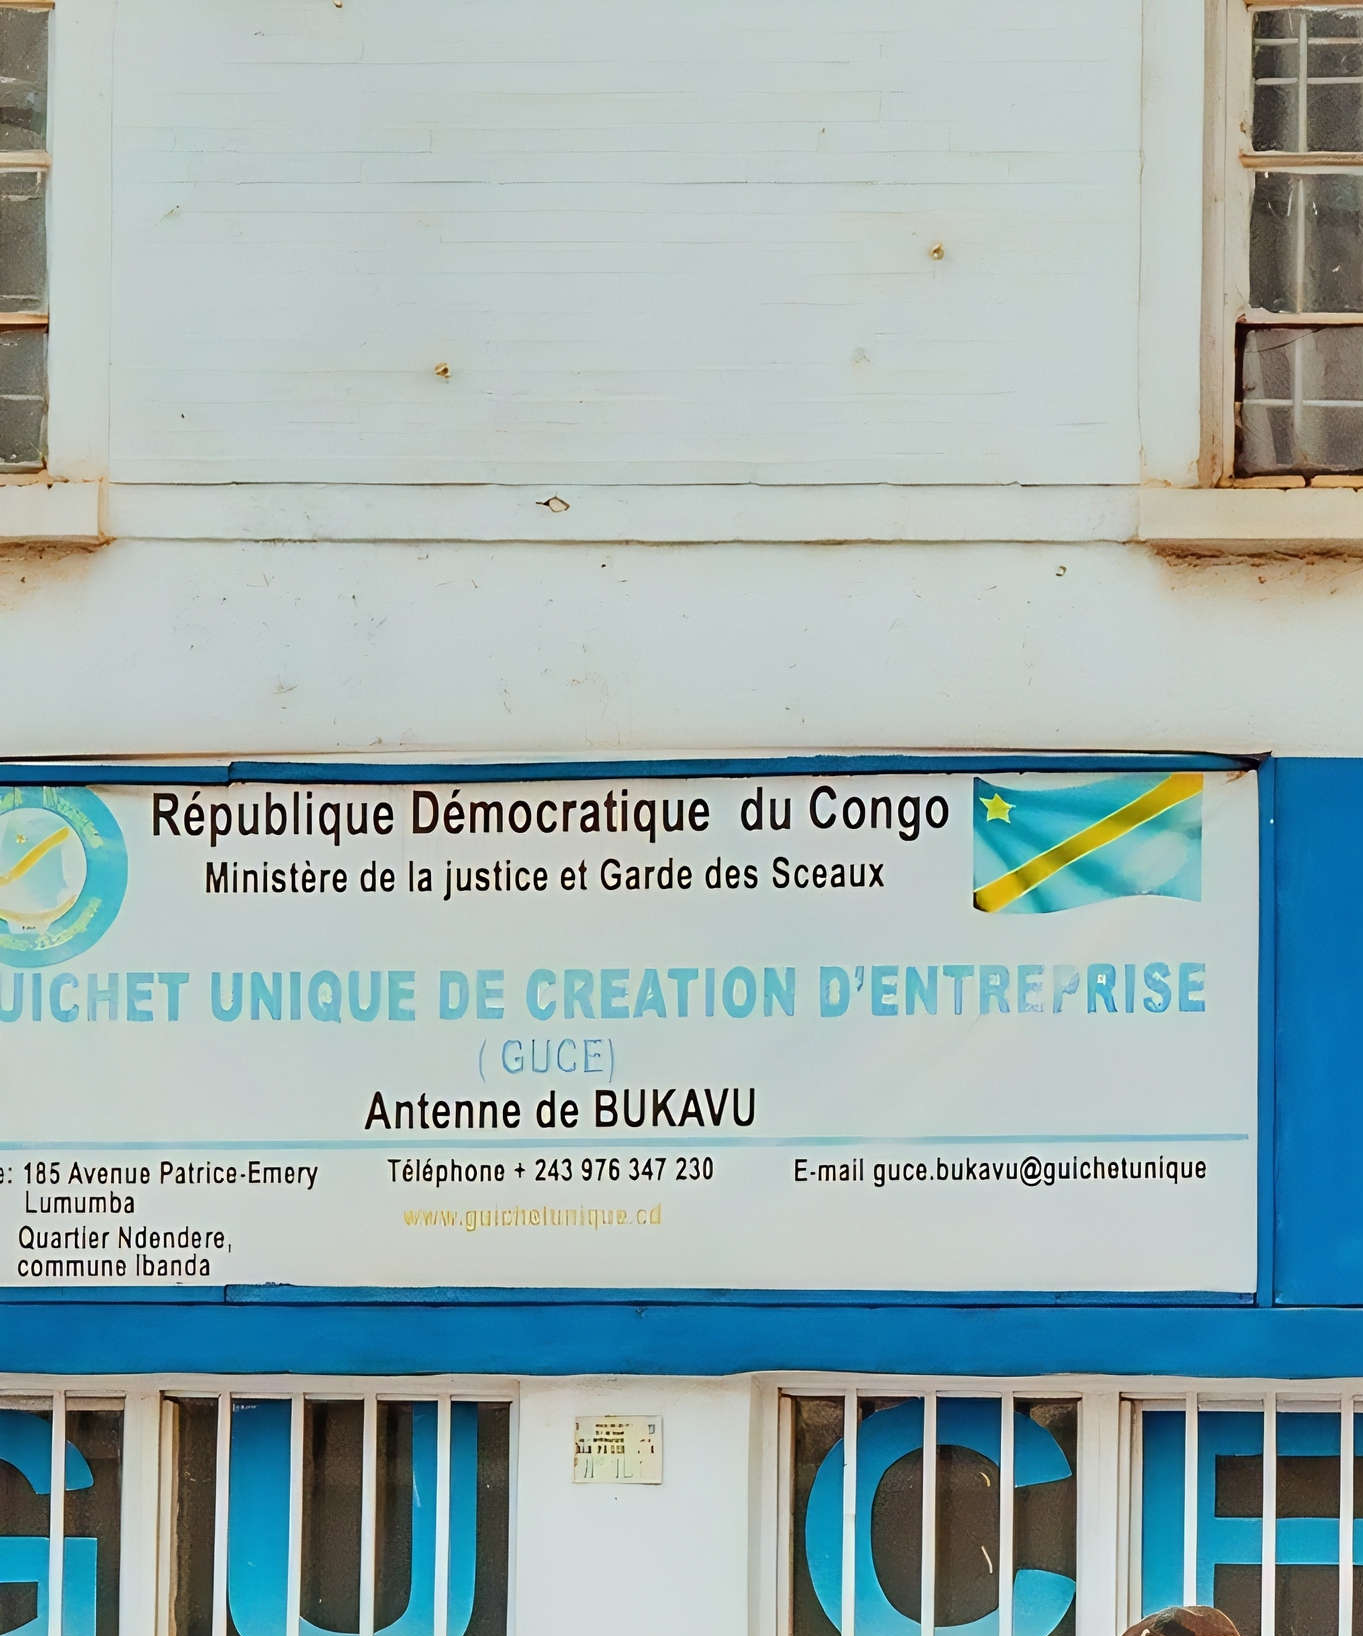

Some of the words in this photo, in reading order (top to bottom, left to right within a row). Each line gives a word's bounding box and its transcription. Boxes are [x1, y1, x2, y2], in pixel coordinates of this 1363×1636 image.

[152, 788, 395, 847] République
[411, 787, 710, 844] Démocratique
[740, 786, 791, 832] du
[809, 785, 950, 842] Congo
[205, 859, 348, 894] Ministère
[360, 860, 395, 893] de
[408, 860, 433, 893] la
[443, 859, 548, 902] justice
[560, 859, 588, 891] et
[600, 857, 693, 891] Garde
[705, 856, 759, 890] des
[772, 856, 885, 889] Sceaux
[210, 969, 416, 1024] UNIQUE
[439, 968, 505, 1021] DE
[525, 964, 797, 1022] CREATION
[364, 1090, 521, 1130] Antenne
[536, 1089, 579, 1129] de
[594, 1087, 756, 1128] BUKAVU
[23, 1161, 61, 1185] 185
[67, 1161, 151, 1185] Avenue
[160, 1160, 319, 1191] Patrice-Emery
[387, 1158, 505, 1188] Téléphone
[514, 1162, 526, 1179] +
[535, 1158, 573, 1182] 243
[581, 1157, 620, 1182] 976
[628, 1157, 667, 1181] 347
[675, 1156, 714, 1181] 230
[794, 1158, 864, 1182] E-mail
[873, 1155, 1207, 1188] guce.bukavu@guichetunique
[25, 1190, 135, 1214] Lumumba
[18, 1225, 110, 1251] Quartier
[118, 1225, 233, 1256] Ndendere,
[17, 1259, 127, 1277] commune
[136, 1253, 210, 1277] Ibanda
